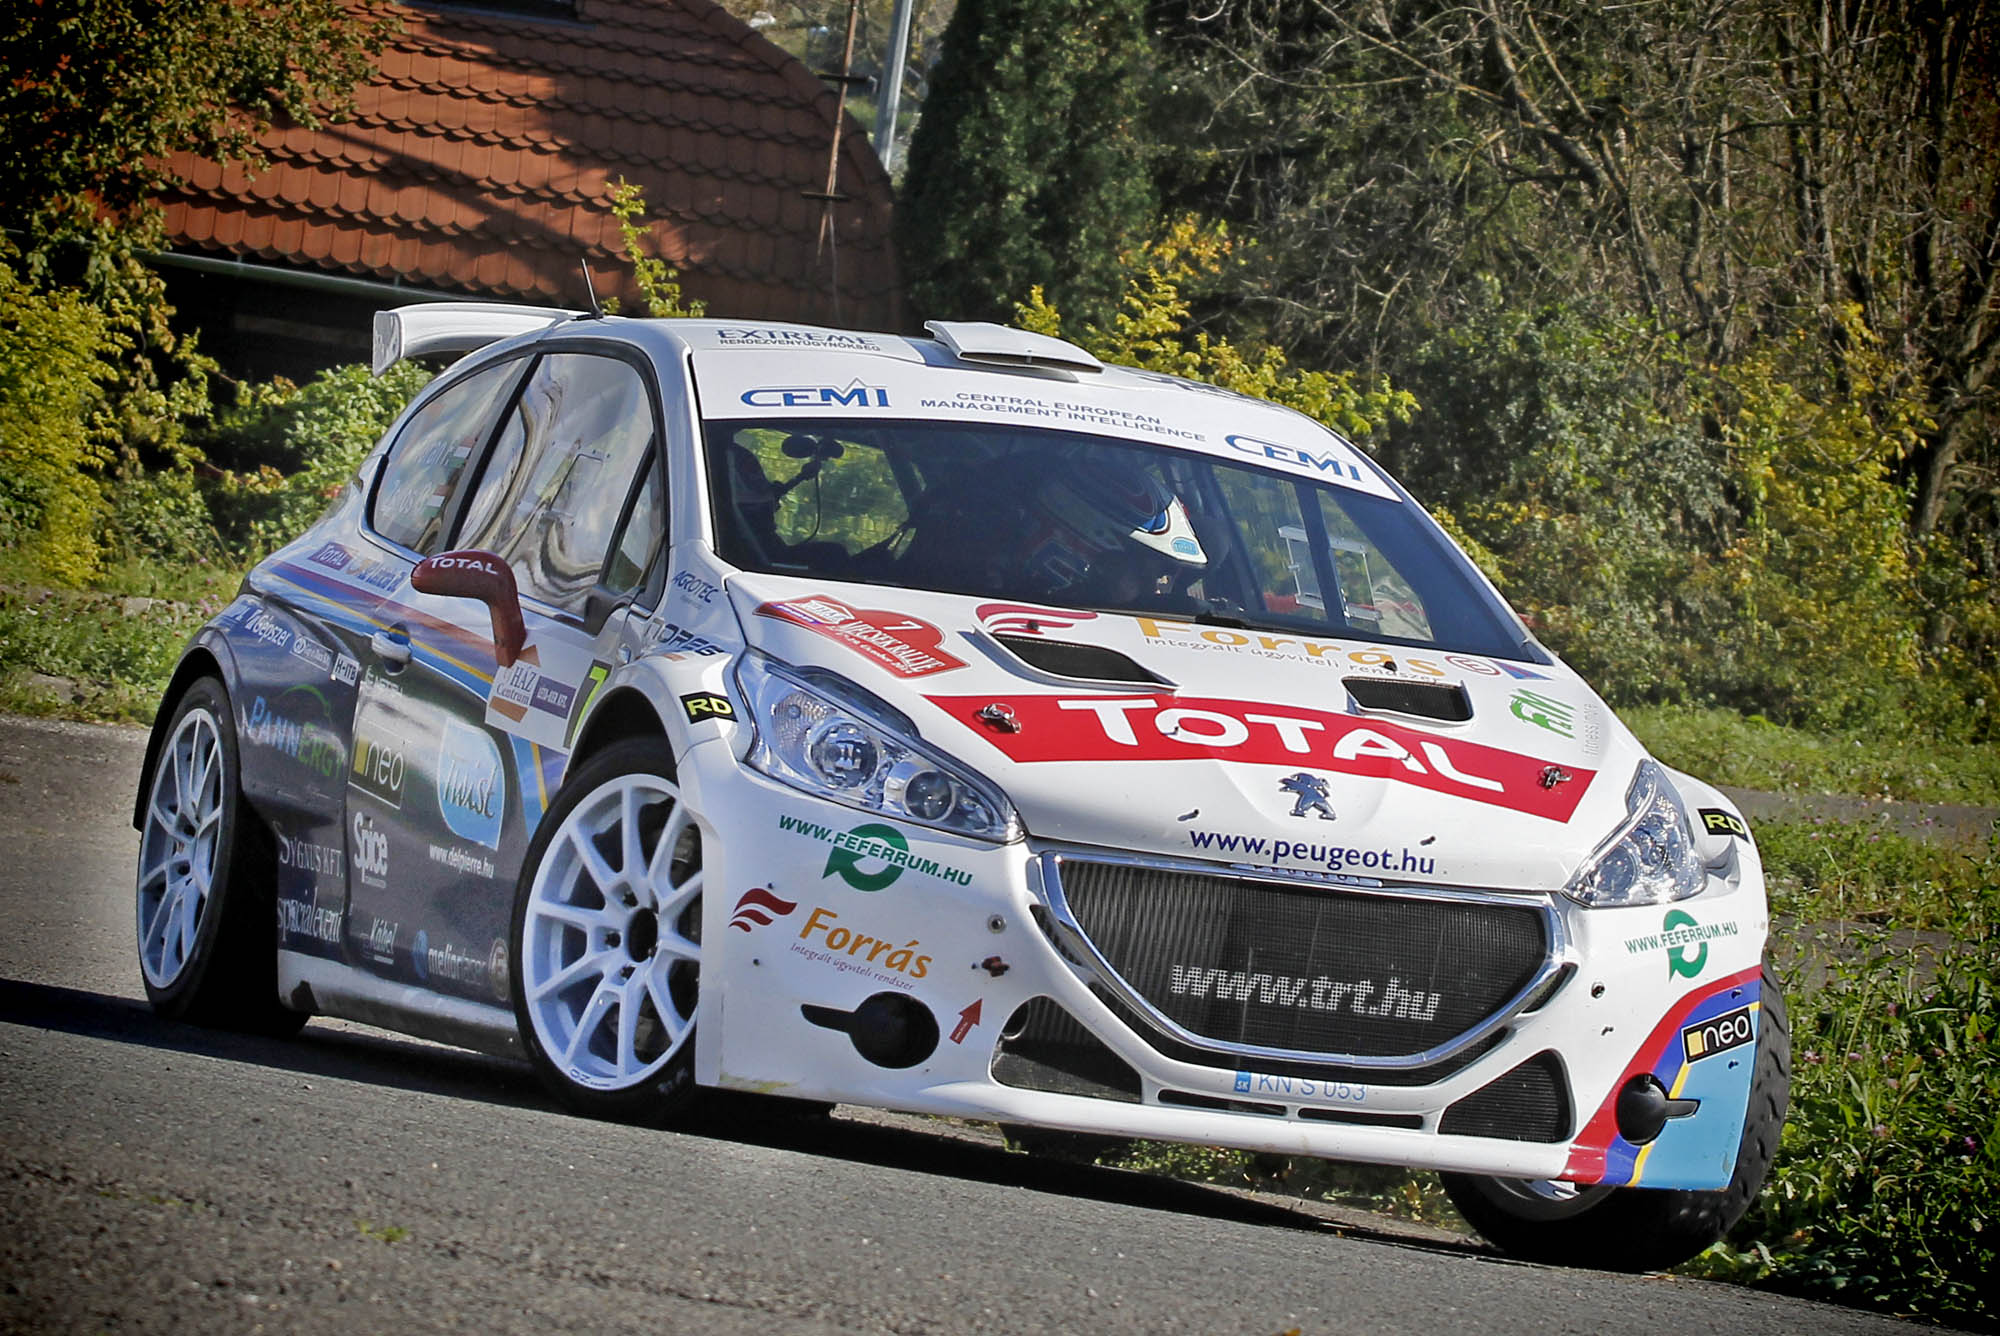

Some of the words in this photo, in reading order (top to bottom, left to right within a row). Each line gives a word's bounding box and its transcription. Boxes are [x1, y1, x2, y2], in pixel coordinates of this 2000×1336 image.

[716, 328, 875, 346] EXTREME
[740, 386, 891, 407] CEMI
[956, 393, 1049, 408] CENTRAL
[1054, 402, 1161, 424] EUROPEAN
[921, 400, 1062, 417] MANAGEMENT
[1067, 412, 1207, 441] INTELLIGENCE
[1225, 434, 1362, 482] CEMI
[431, 556, 499, 575] TOTAL
[672, 571, 719, 603] AGROTEC
[882, 620, 923, 631] 7
[885, 642, 946, 673] RALLYE
[1136, 617, 1446, 677] Forrás
[686, 697, 733, 717] RD
[1057, 698, 1505, 793] TOTAL
[365, 741, 405, 791] neo
[443, 759, 498, 820] Twist
[1703, 814, 1745, 834] RD
[354, 812, 388, 883] Spice
[778, 814, 974, 887] WWW.FEFERRUM.HU
[1189, 830, 1436, 875] www.peugeot.hu
[798, 907, 932, 979] Forrás
[1624, 921, 1739, 954] WWW.FEFERRUM.HU
[1170, 964, 1441, 1022] www.trt.hu
[1702, 1015, 1750, 1052] neo
[1259, 1074, 1292, 1094] KN
